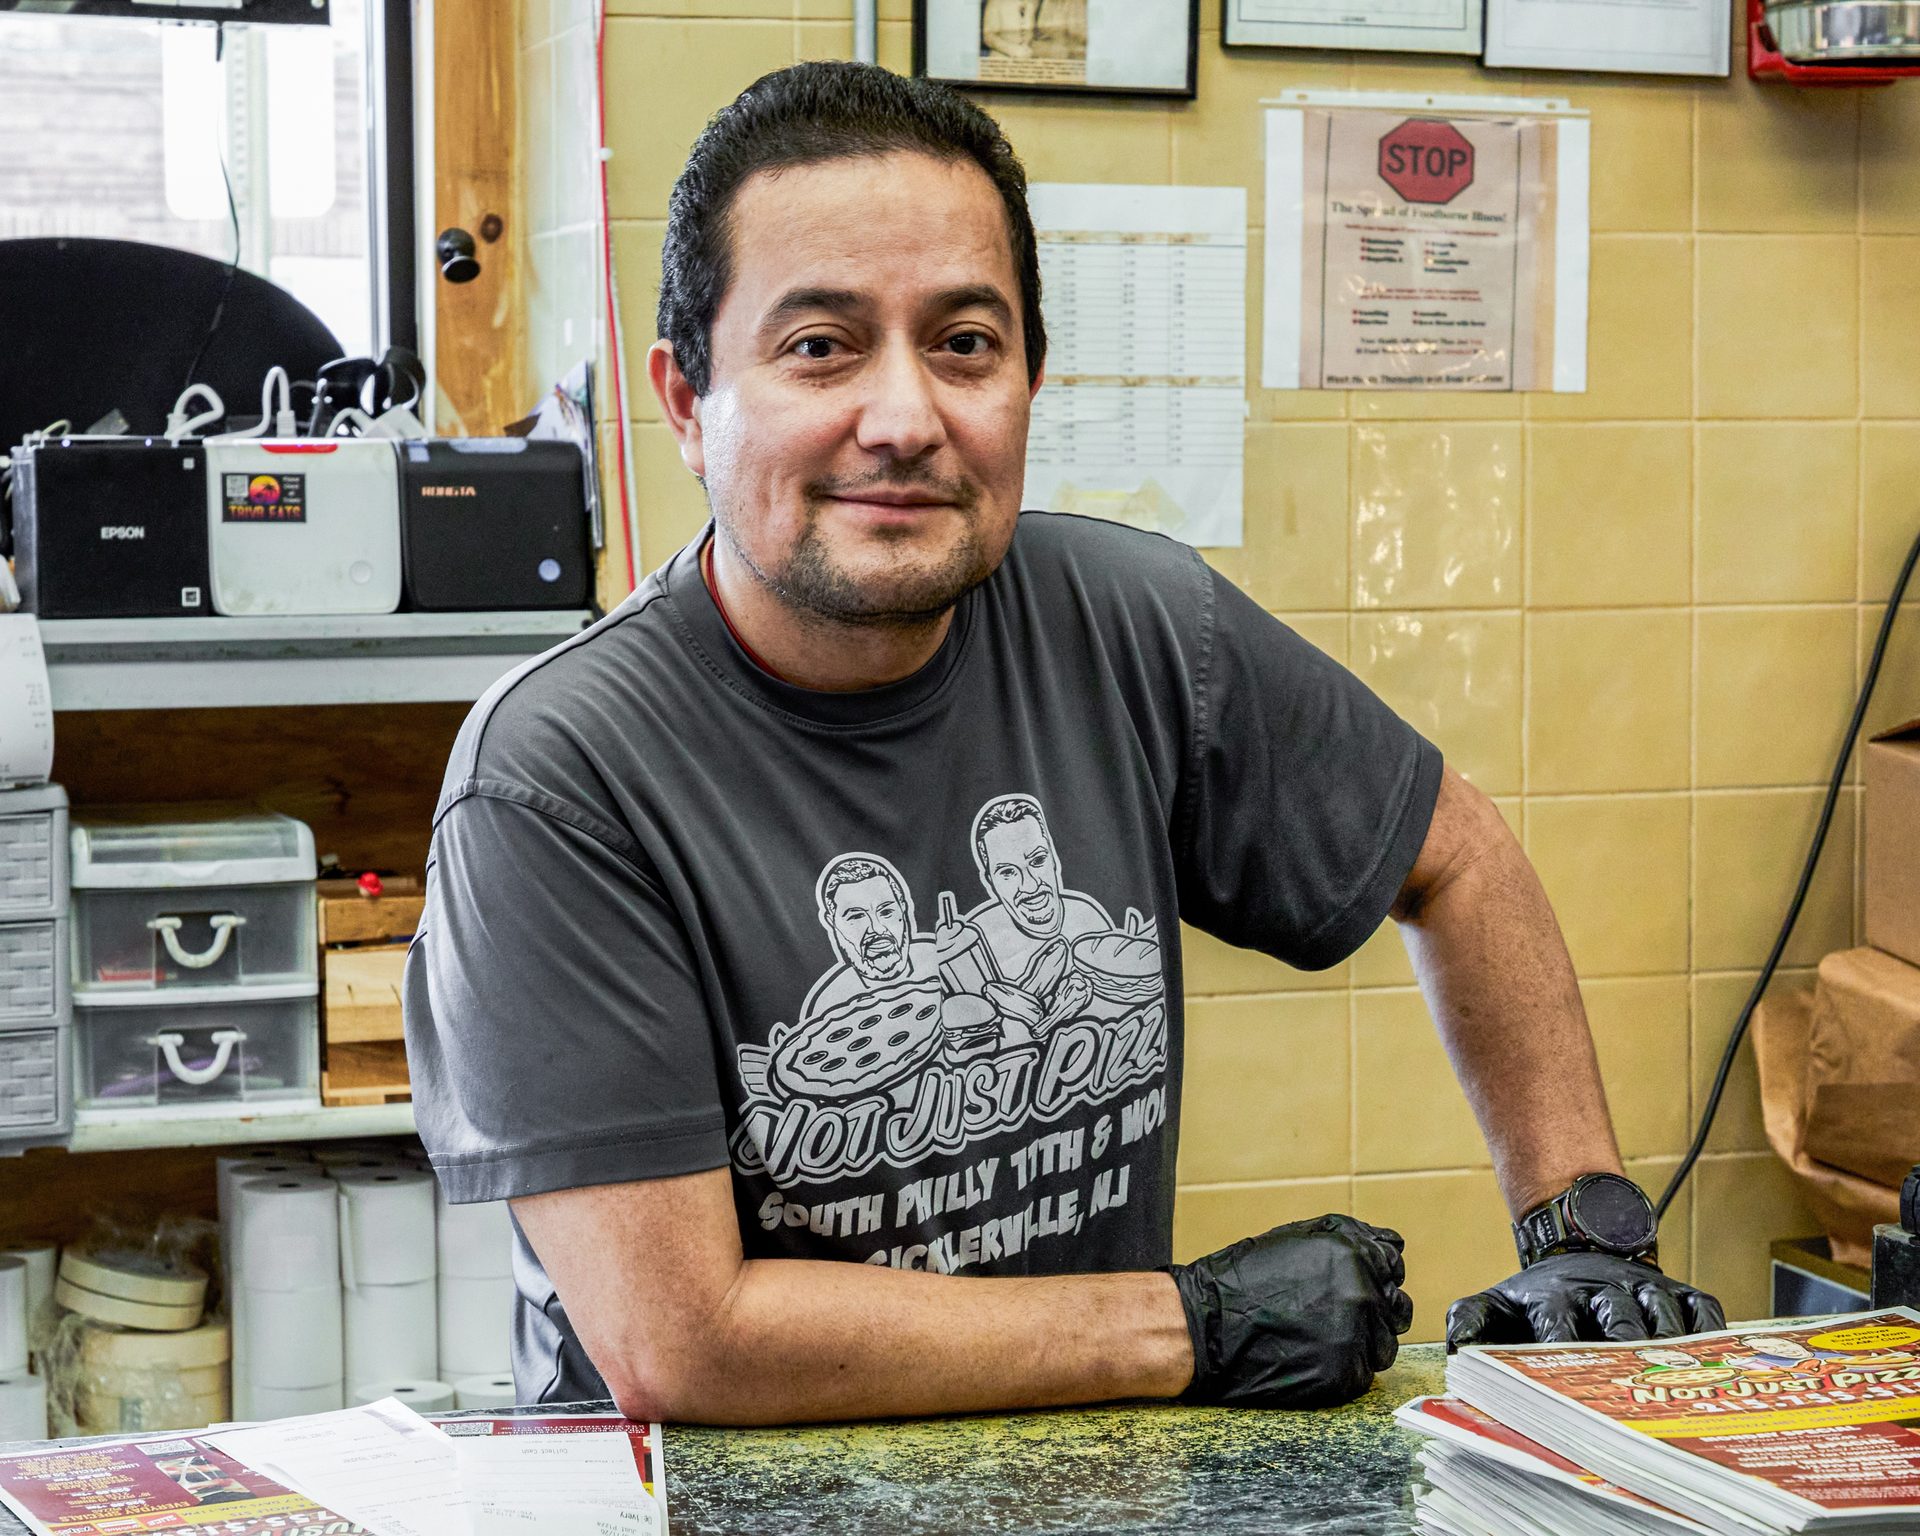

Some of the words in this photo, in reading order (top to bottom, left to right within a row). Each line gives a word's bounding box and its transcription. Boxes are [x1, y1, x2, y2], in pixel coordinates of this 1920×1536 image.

[1387, 144, 1467, 178] STOP
[1357, 203, 1396, 218] Sprad
[101, 526, 145, 541] EPSON
[734, 1096, 885, 1178] NOT
[891, 1048, 1038, 1150] JUST
[1040, 1003, 1167, 1108] PIZZ
[758, 1190, 885, 1238] SOUTH
[896, 1157, 1000, 1227] PHILLY
[1010, 1127, 1084, 1182] 11TH
[1090, 1115, 1113, 1161] &
[1121, 1085, 1167, 1146] WOL
[1089, 1164, 1130, 1218] NJ
[1632, 1386, 1718, 1404] NOT
[1726, 1375, 1825, 1398] JUST
[1692, 1382, 1920, 1413] 215.755.51
[58, 1507, 122, 1522] SPECIALS
[125, 1501, 191, 1515] EVERYDAY
